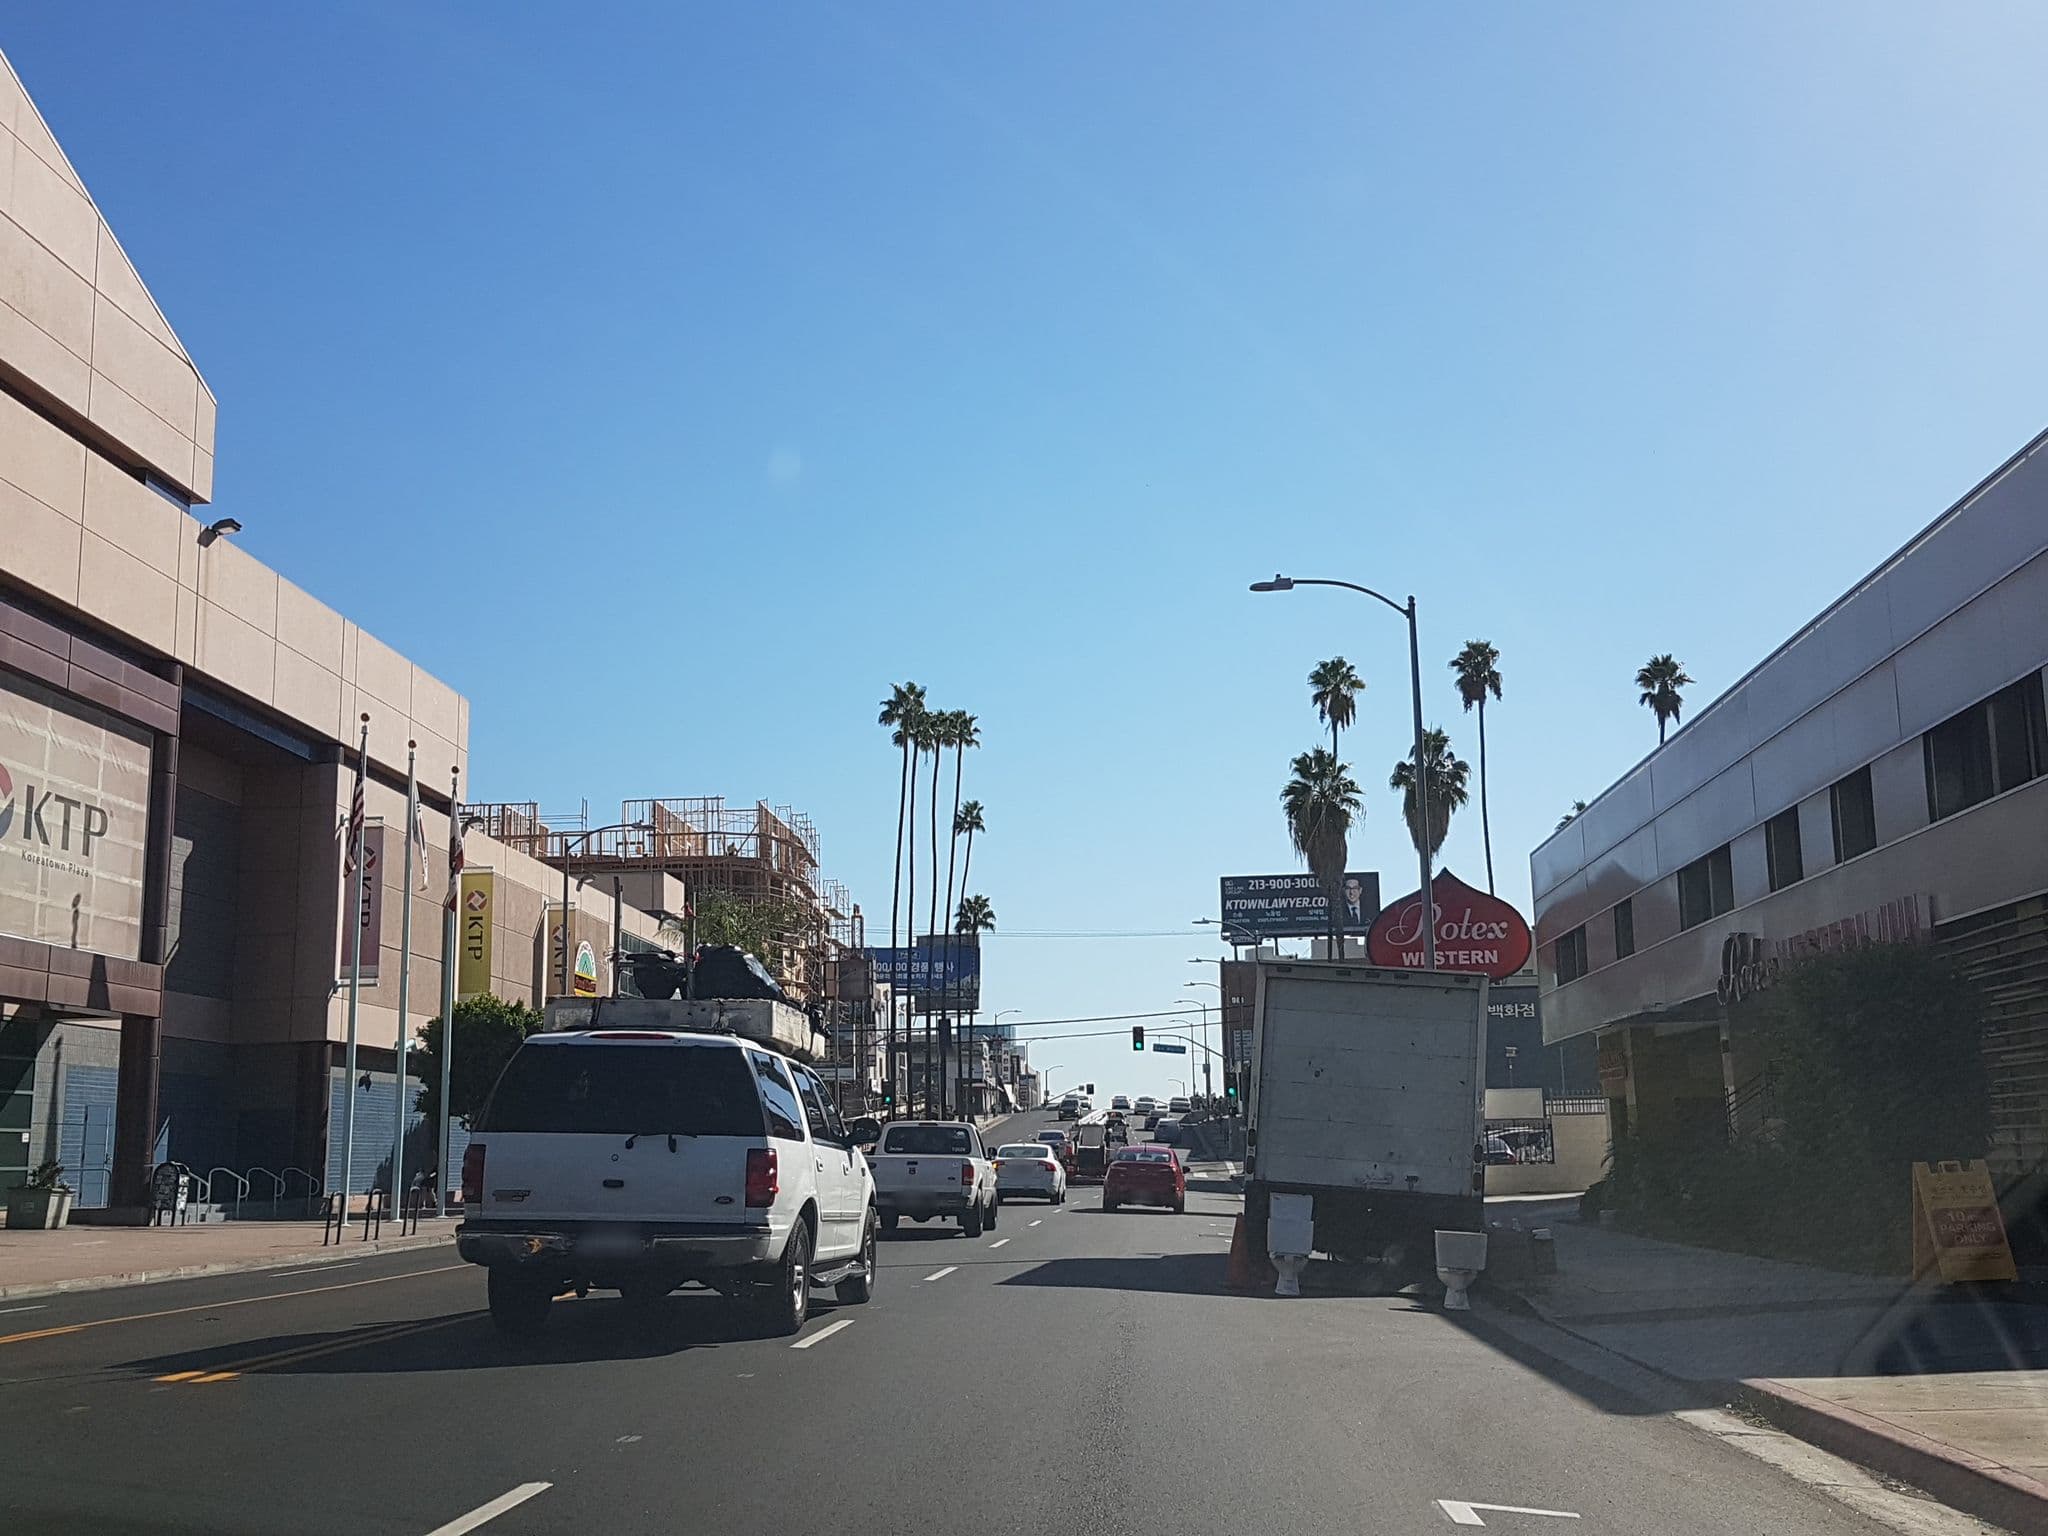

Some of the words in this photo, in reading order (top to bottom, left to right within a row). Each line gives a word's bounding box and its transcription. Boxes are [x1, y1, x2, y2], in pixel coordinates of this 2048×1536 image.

[23, 784, 108, 857] KTP
[22, 849, 66, 872] Koreatown
[68, 862, 89, 878] Plaza
[360, 876, 372, 928] KTP
[468, 916, 483, 961] KTP
[1386, 902, 1508, 946] Rotex
[1488, 1003, 1535, 1018] 백화점
[1940, 1222, 1996, 1233] PARKING
[1954, 1233, 1985, 1244] ONLY
